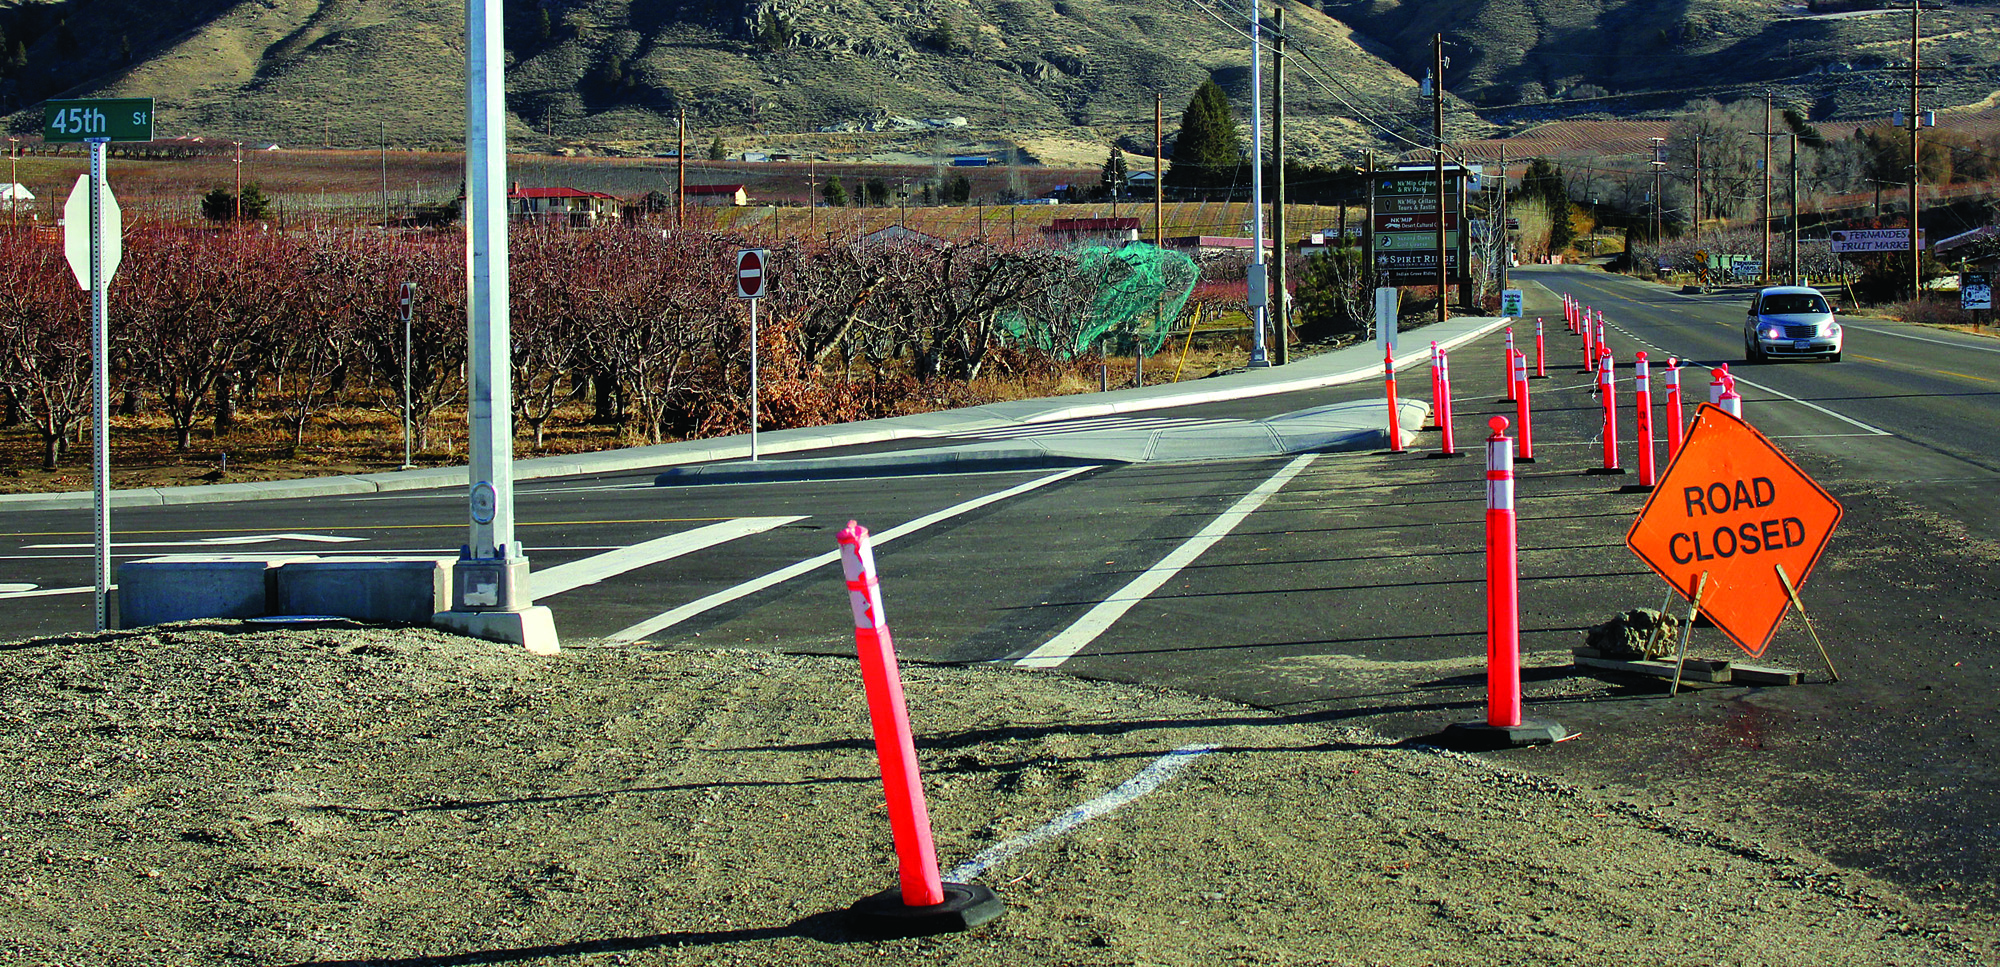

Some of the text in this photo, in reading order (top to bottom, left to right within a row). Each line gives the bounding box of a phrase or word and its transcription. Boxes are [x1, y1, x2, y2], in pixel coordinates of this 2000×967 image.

[52, 107, 147, 134] 45th St
[1849, 230, 1907, 240] FERNANDES
[1841, 241, 1910, 251] FRUIT MARKE
[1390, 255, 1422, 263] SPIRIT
[1684, 476, 1775, 517] ROAD
[1669, 517, 1806, 565] CLOSED
